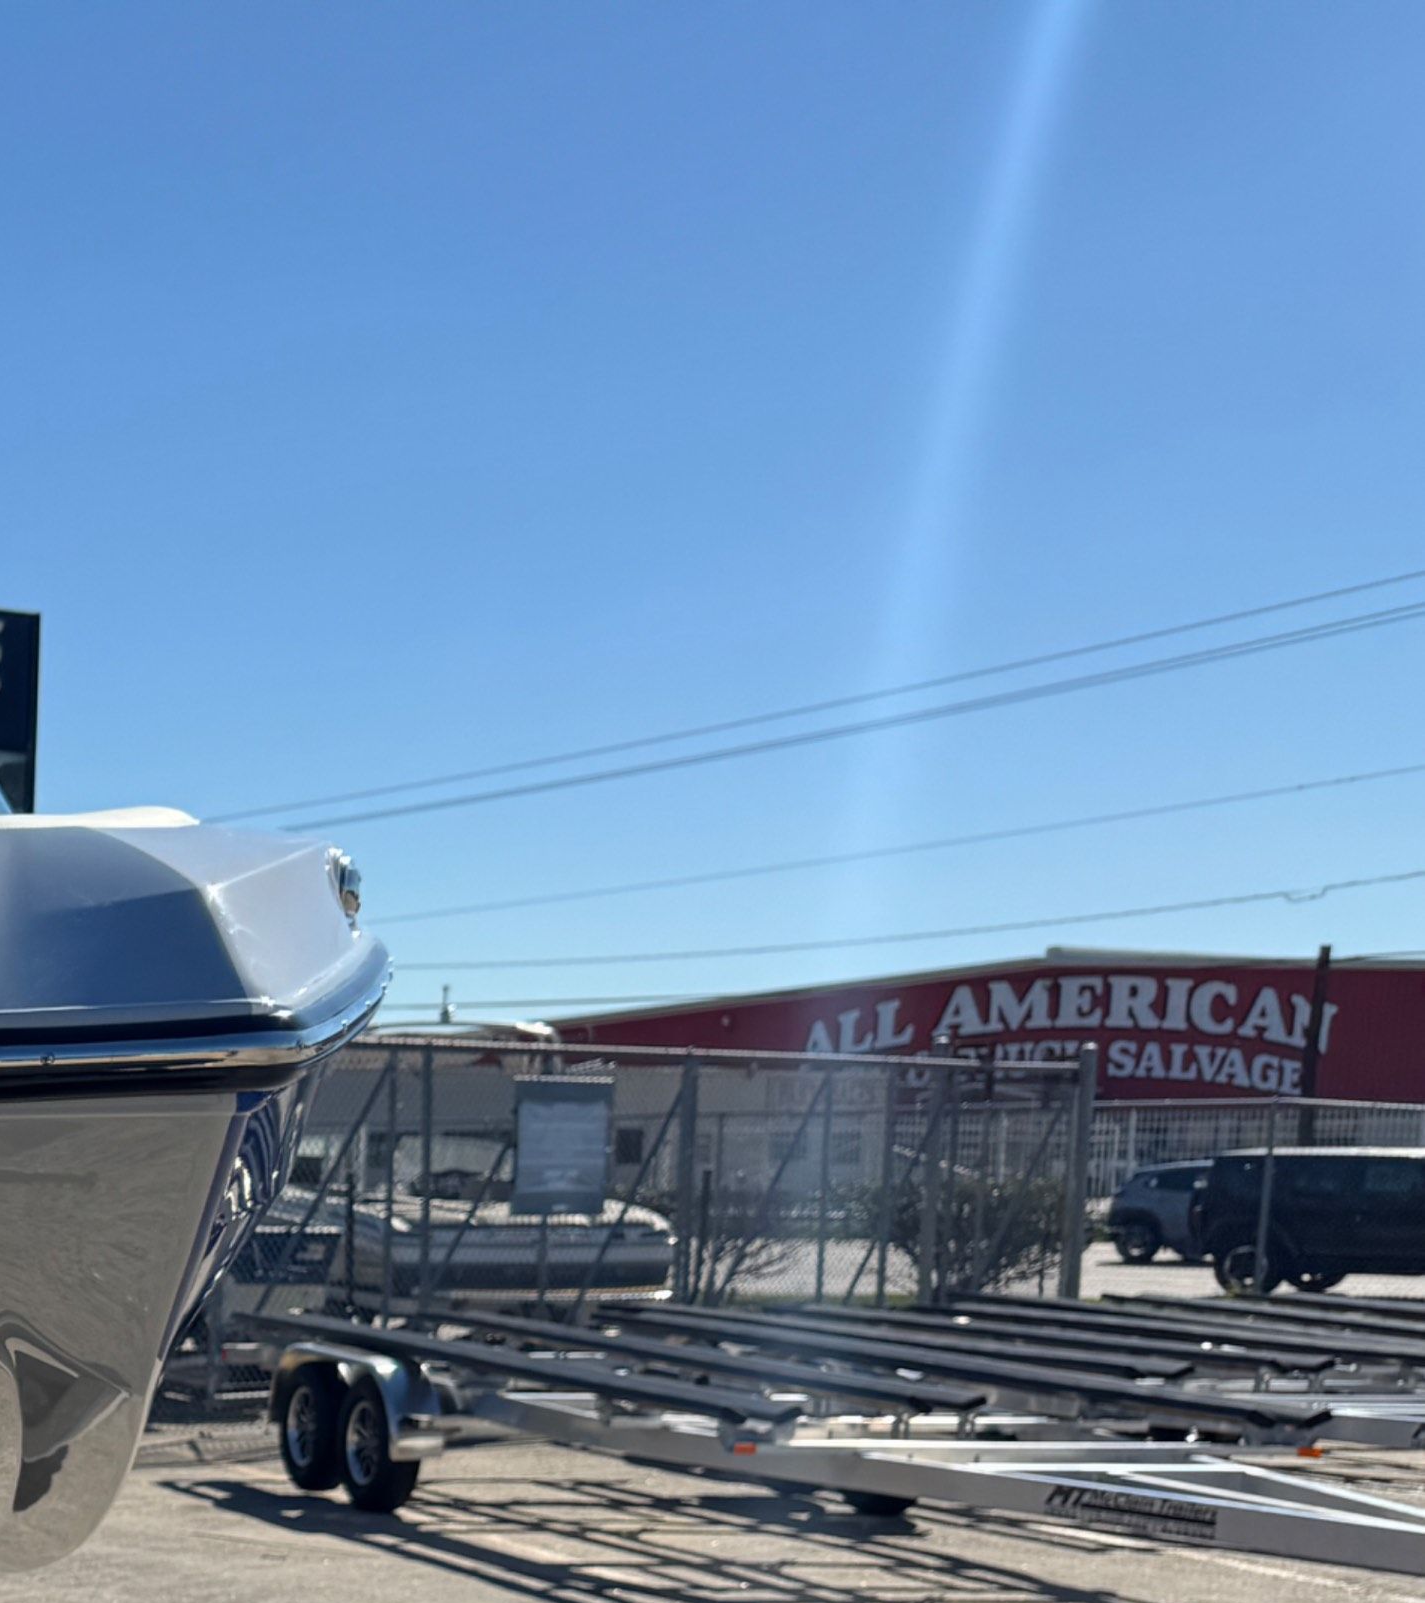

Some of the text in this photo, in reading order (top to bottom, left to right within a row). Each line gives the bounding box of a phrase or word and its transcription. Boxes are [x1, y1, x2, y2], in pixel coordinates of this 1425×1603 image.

[805, 974, 1338, 1054] ALL AMERICAN
[1107, 1040, 1302, 1095] SALVAGE
